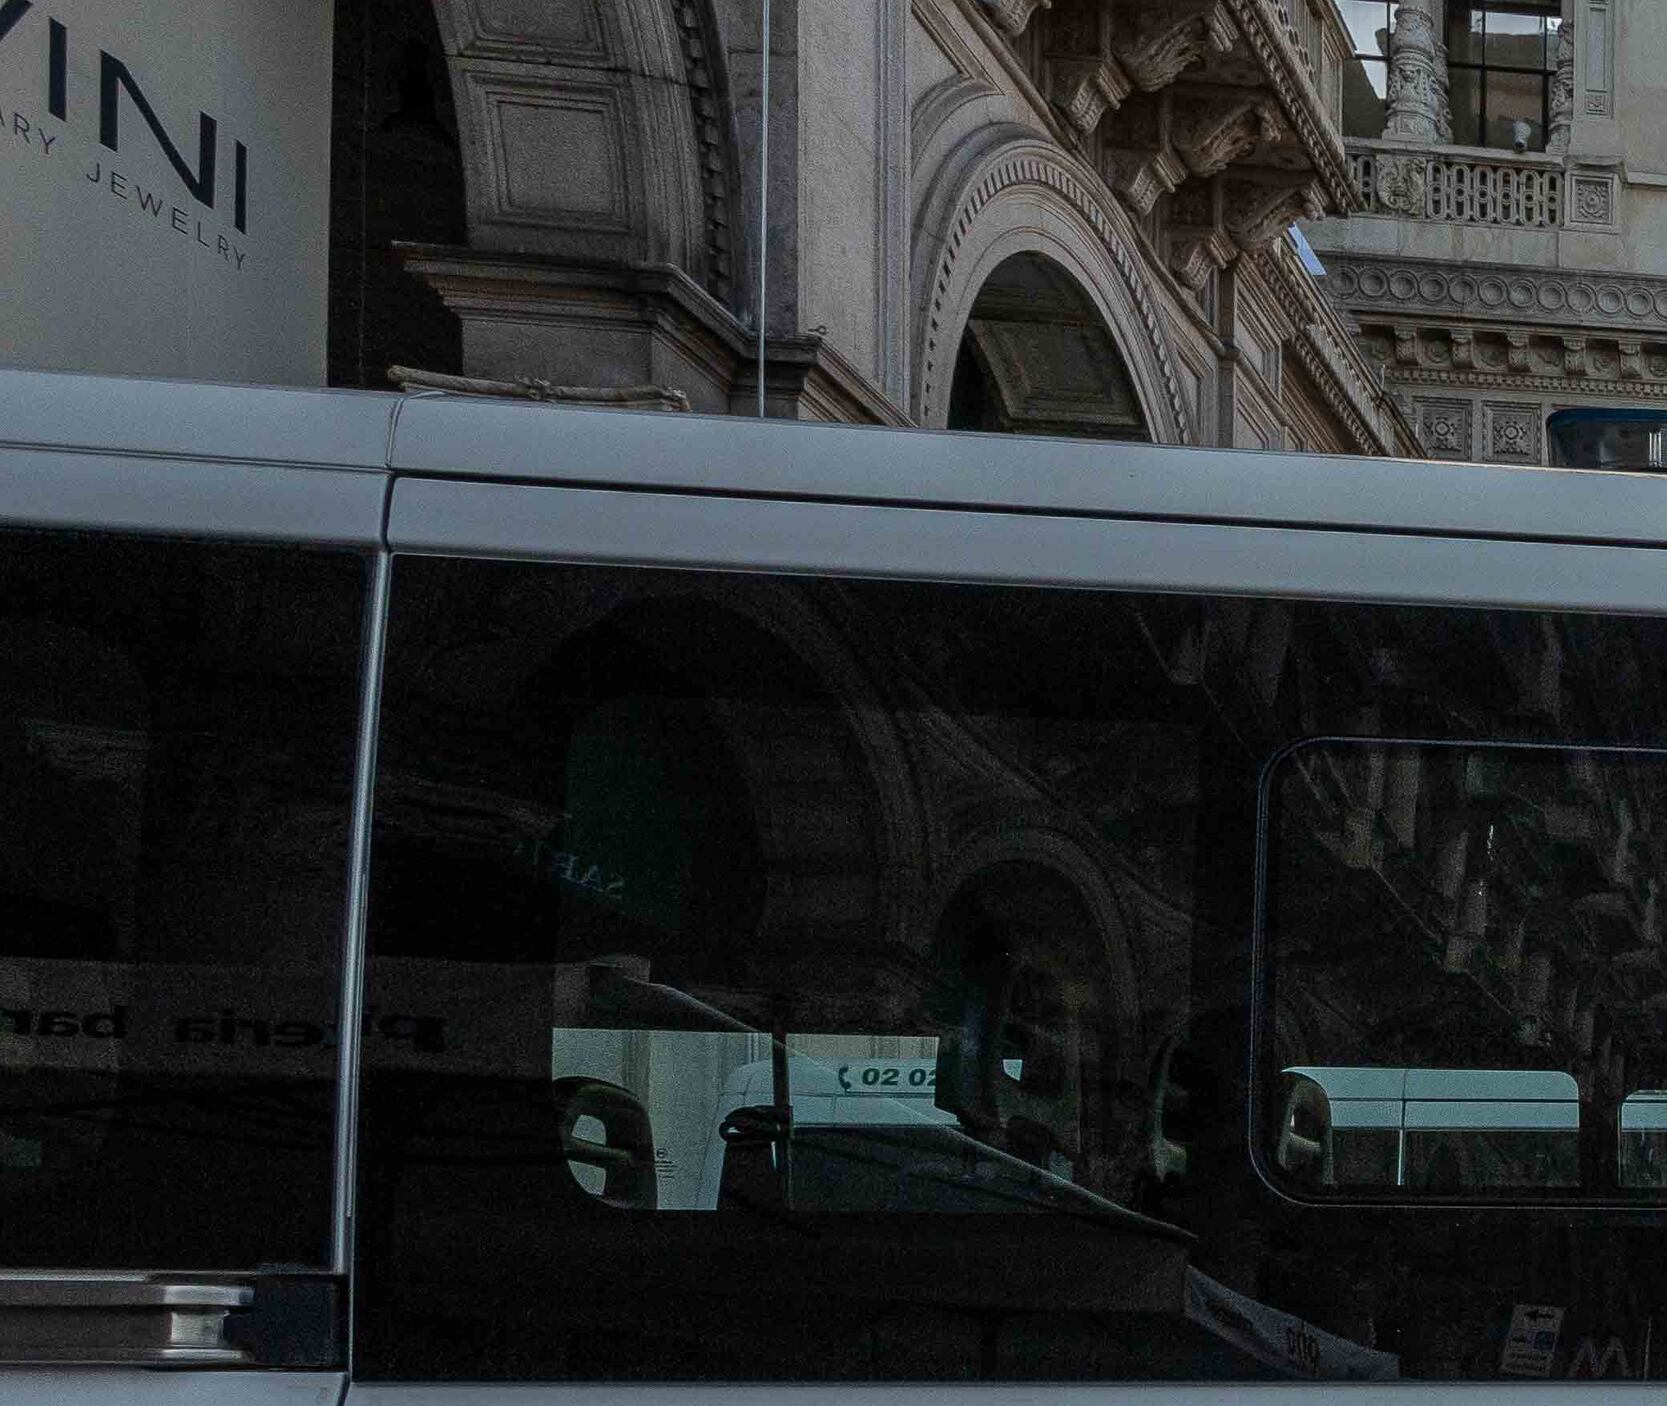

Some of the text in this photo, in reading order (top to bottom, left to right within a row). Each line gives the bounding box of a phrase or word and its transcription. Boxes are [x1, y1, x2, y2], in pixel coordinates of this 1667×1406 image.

[0, 0, 248, 236] INI
[86, 163, 247, 271] JEWELRY
[862, 1067, 900, 1086] 02
